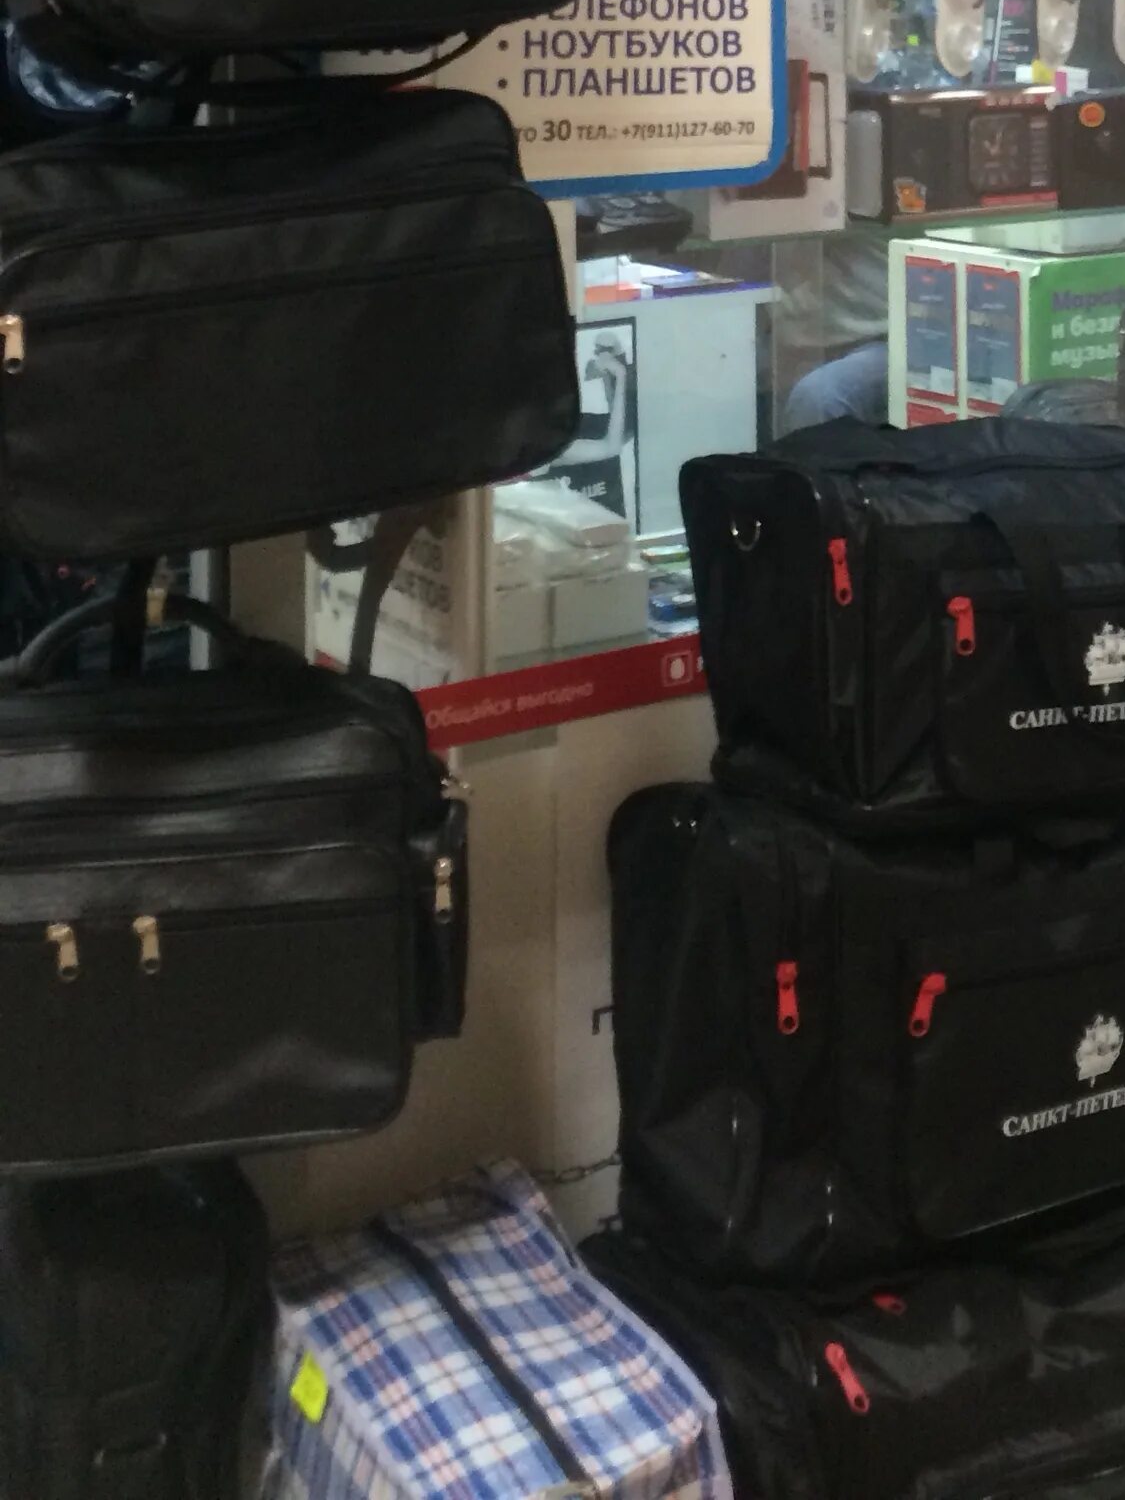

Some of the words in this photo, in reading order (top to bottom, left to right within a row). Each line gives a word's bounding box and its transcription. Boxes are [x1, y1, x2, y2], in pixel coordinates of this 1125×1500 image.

[522, 28, 743, 60] НОУТБУКОВ
[522, 66, 756, 99] ПЛАНШЕТОВ
[542, 119, 572, 143] 30
